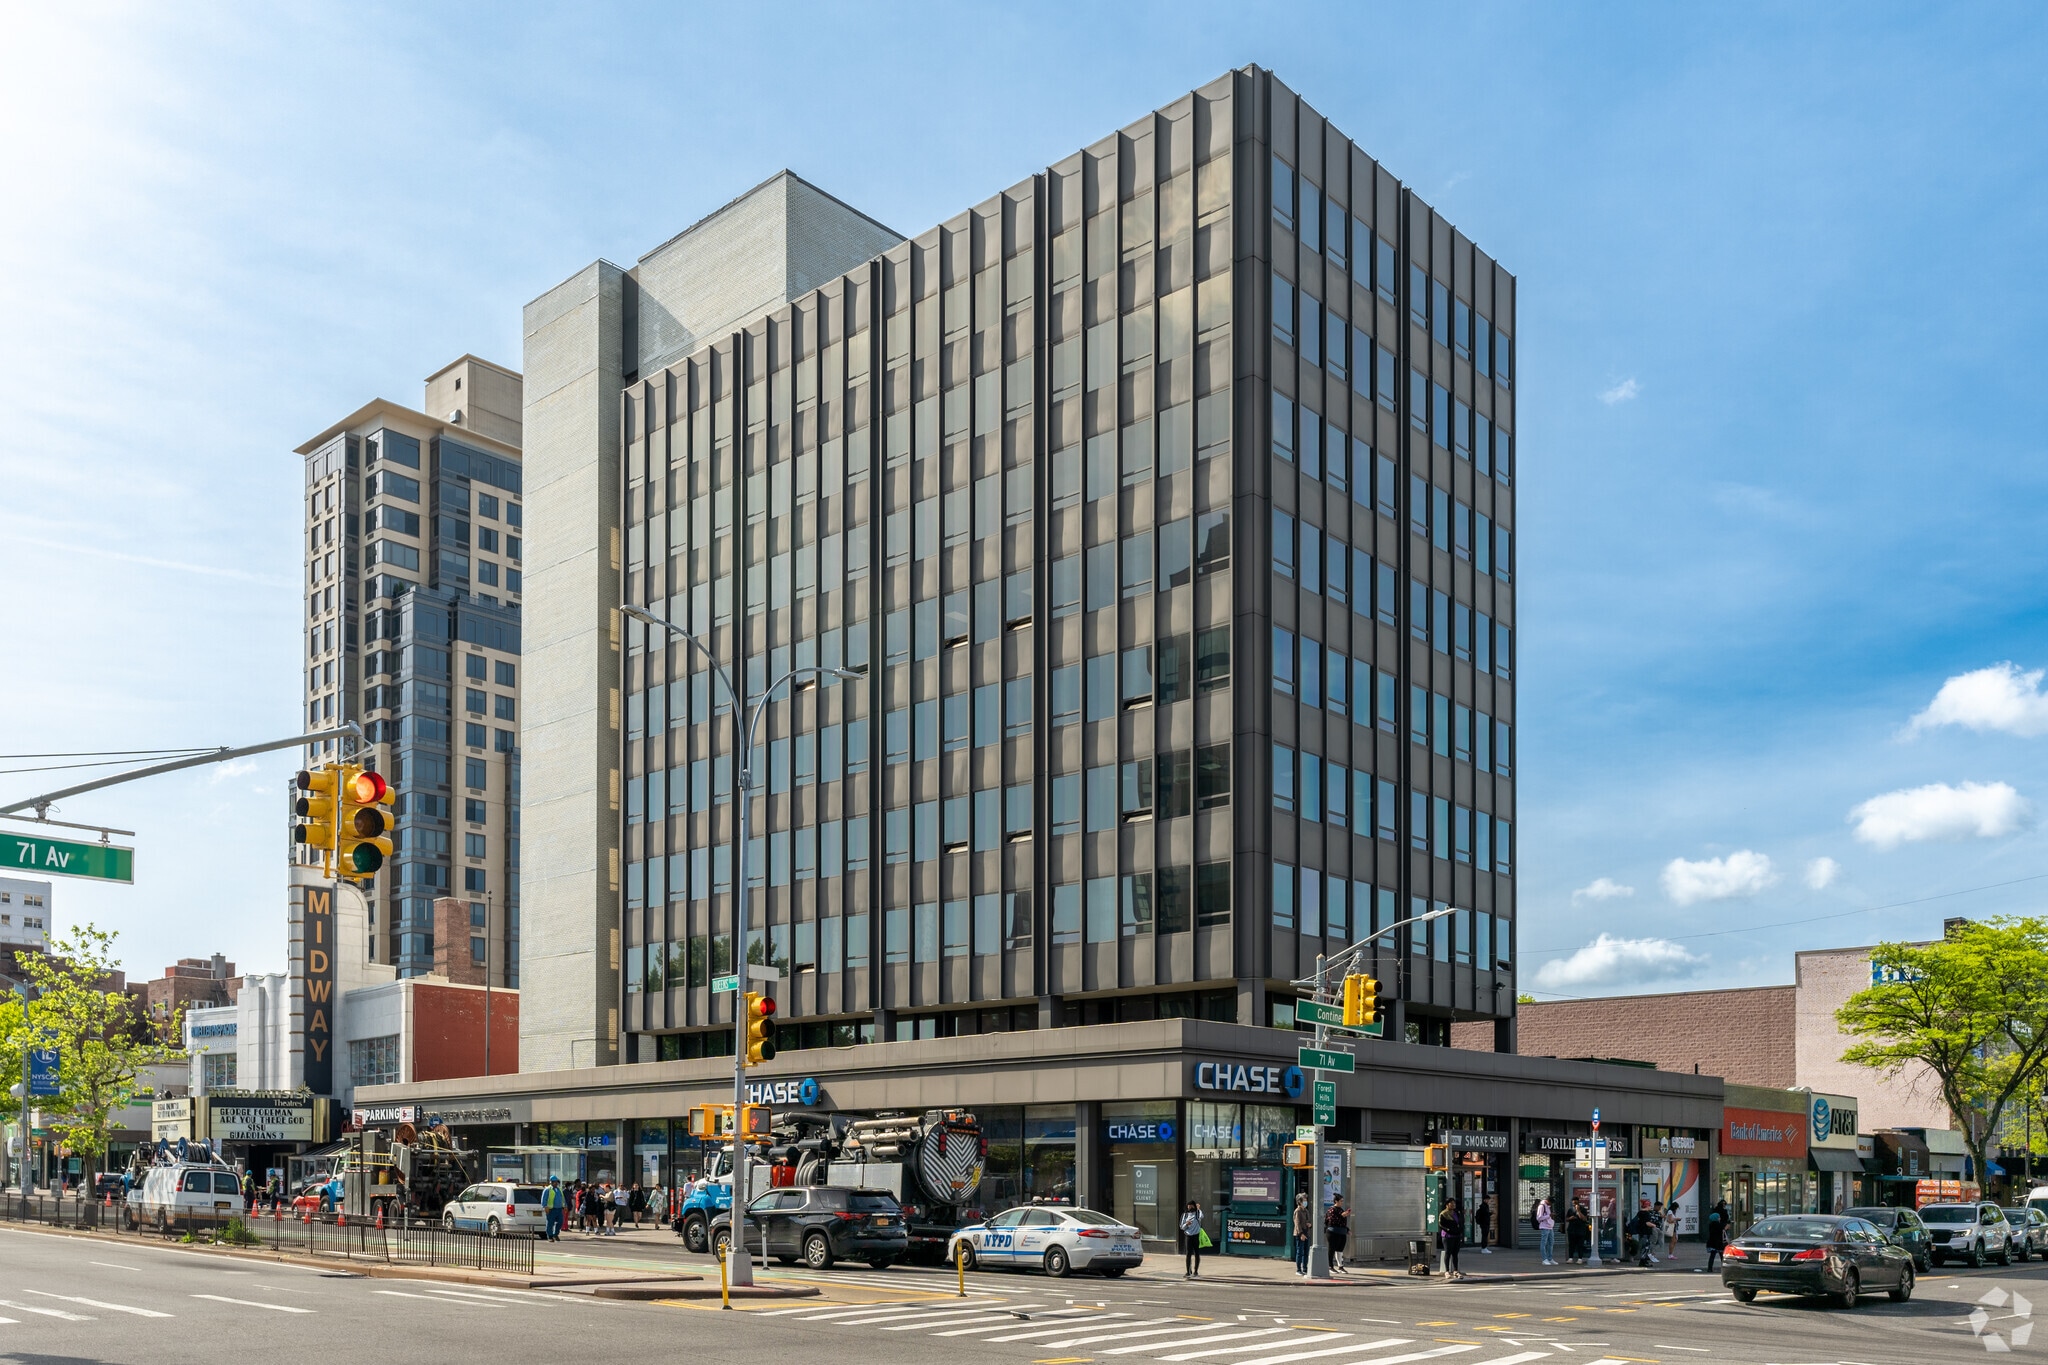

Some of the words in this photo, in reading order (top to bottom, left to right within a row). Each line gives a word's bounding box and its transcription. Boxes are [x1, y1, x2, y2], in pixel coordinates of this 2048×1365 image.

[16, 841, 36, 865] 71
[45, 845, 70, 868] Av
[307, 890, 332, 1062] MIDWAY
[1317, 1008, 1343, 1023] Contine
[1319, 1053, 1326, 1066] 71
[1327, 1054, 1336, 1067] Av
[1198, 1062, 1281, 1094] CHASE
[1317, 1083, 1332, 1093] Forest
[1319, 1093, 1330, 1102] Hills
[219, 1108, 252, 1116] GEORGE
[254, 1108, 293, 1117] FOREMAN
[1315, 1102, 1335, 1111] Stadium
[220, 1116, 237, 1124] ARE
[240, 1116, 256, 1124] YOU
[260, 1116, 286, 1125] THERE
[288, 1117, 305, 1125] GOD
[365, 1107, 400, 1121] PARKING
[247, 1124, 267, 1132] SISU
[1830, 1108, 1858, 1136] AT&T
[229, 1131, 277, 1140] GUARDIANS
[1108, 1124, 1157, 1139] CHASE
[1194, 1124, 1232, 1139] CHASE
[1730, 1121, 1748, 1140] Bank
[1748, 1123, 1756, 1140] of
[1756, 1123, 1783, 1143] America
[1465, 1135, 1489, 1147] SMOKE
[1489, 1136, 1507, 1148] SHOP
[1608, 1140, 1623, 1152] ERS
[983, 1233, 1012, 1248] NYPD
